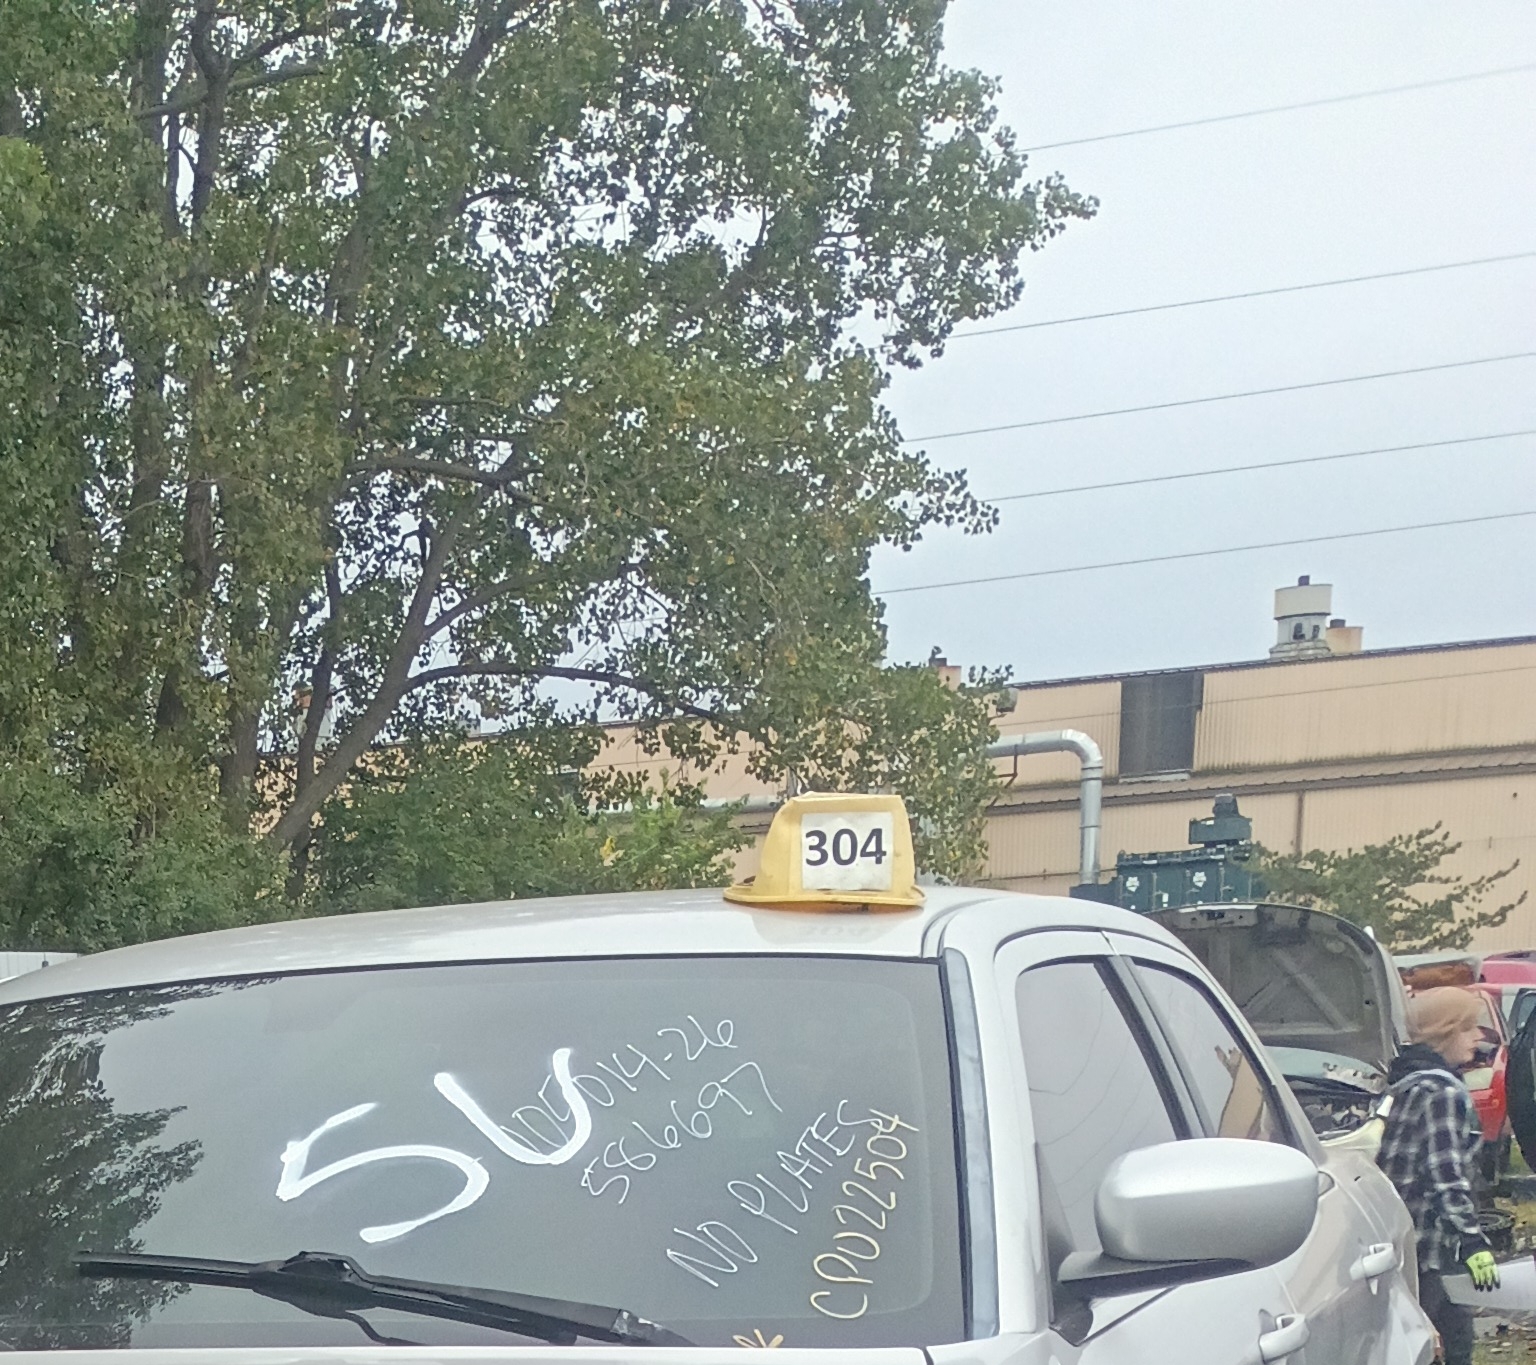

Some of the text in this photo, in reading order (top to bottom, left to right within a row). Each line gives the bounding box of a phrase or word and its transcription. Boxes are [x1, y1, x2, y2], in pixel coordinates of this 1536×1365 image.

[804, 827, 888, 867] 304
[580, 1061, 784, 1204] 586697
[666, 1098, 884, 1288] NO PLATES
